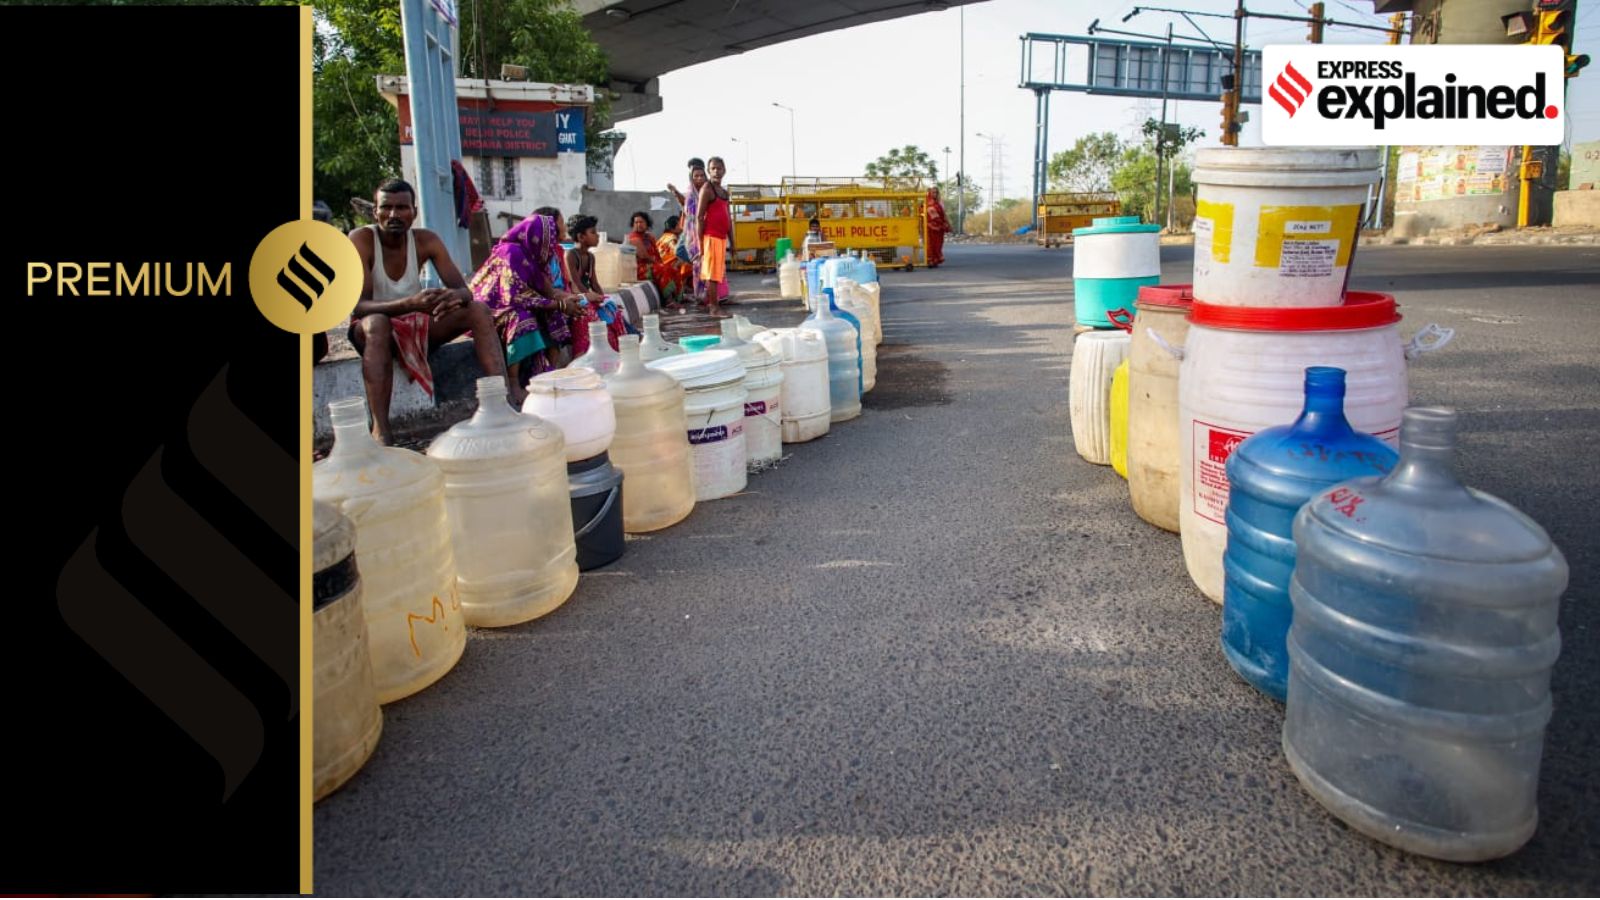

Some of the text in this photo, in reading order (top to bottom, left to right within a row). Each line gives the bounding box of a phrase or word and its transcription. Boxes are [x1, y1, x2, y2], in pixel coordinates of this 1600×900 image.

[516, 118, 535, 127] YOU
[496, 129, 530, 138] POLICE
[558, 133, 577, 144] GHAT
[504, 141, 548, 150] DISTRICT
[821, 225, 888, 238] ELHI POLICE
